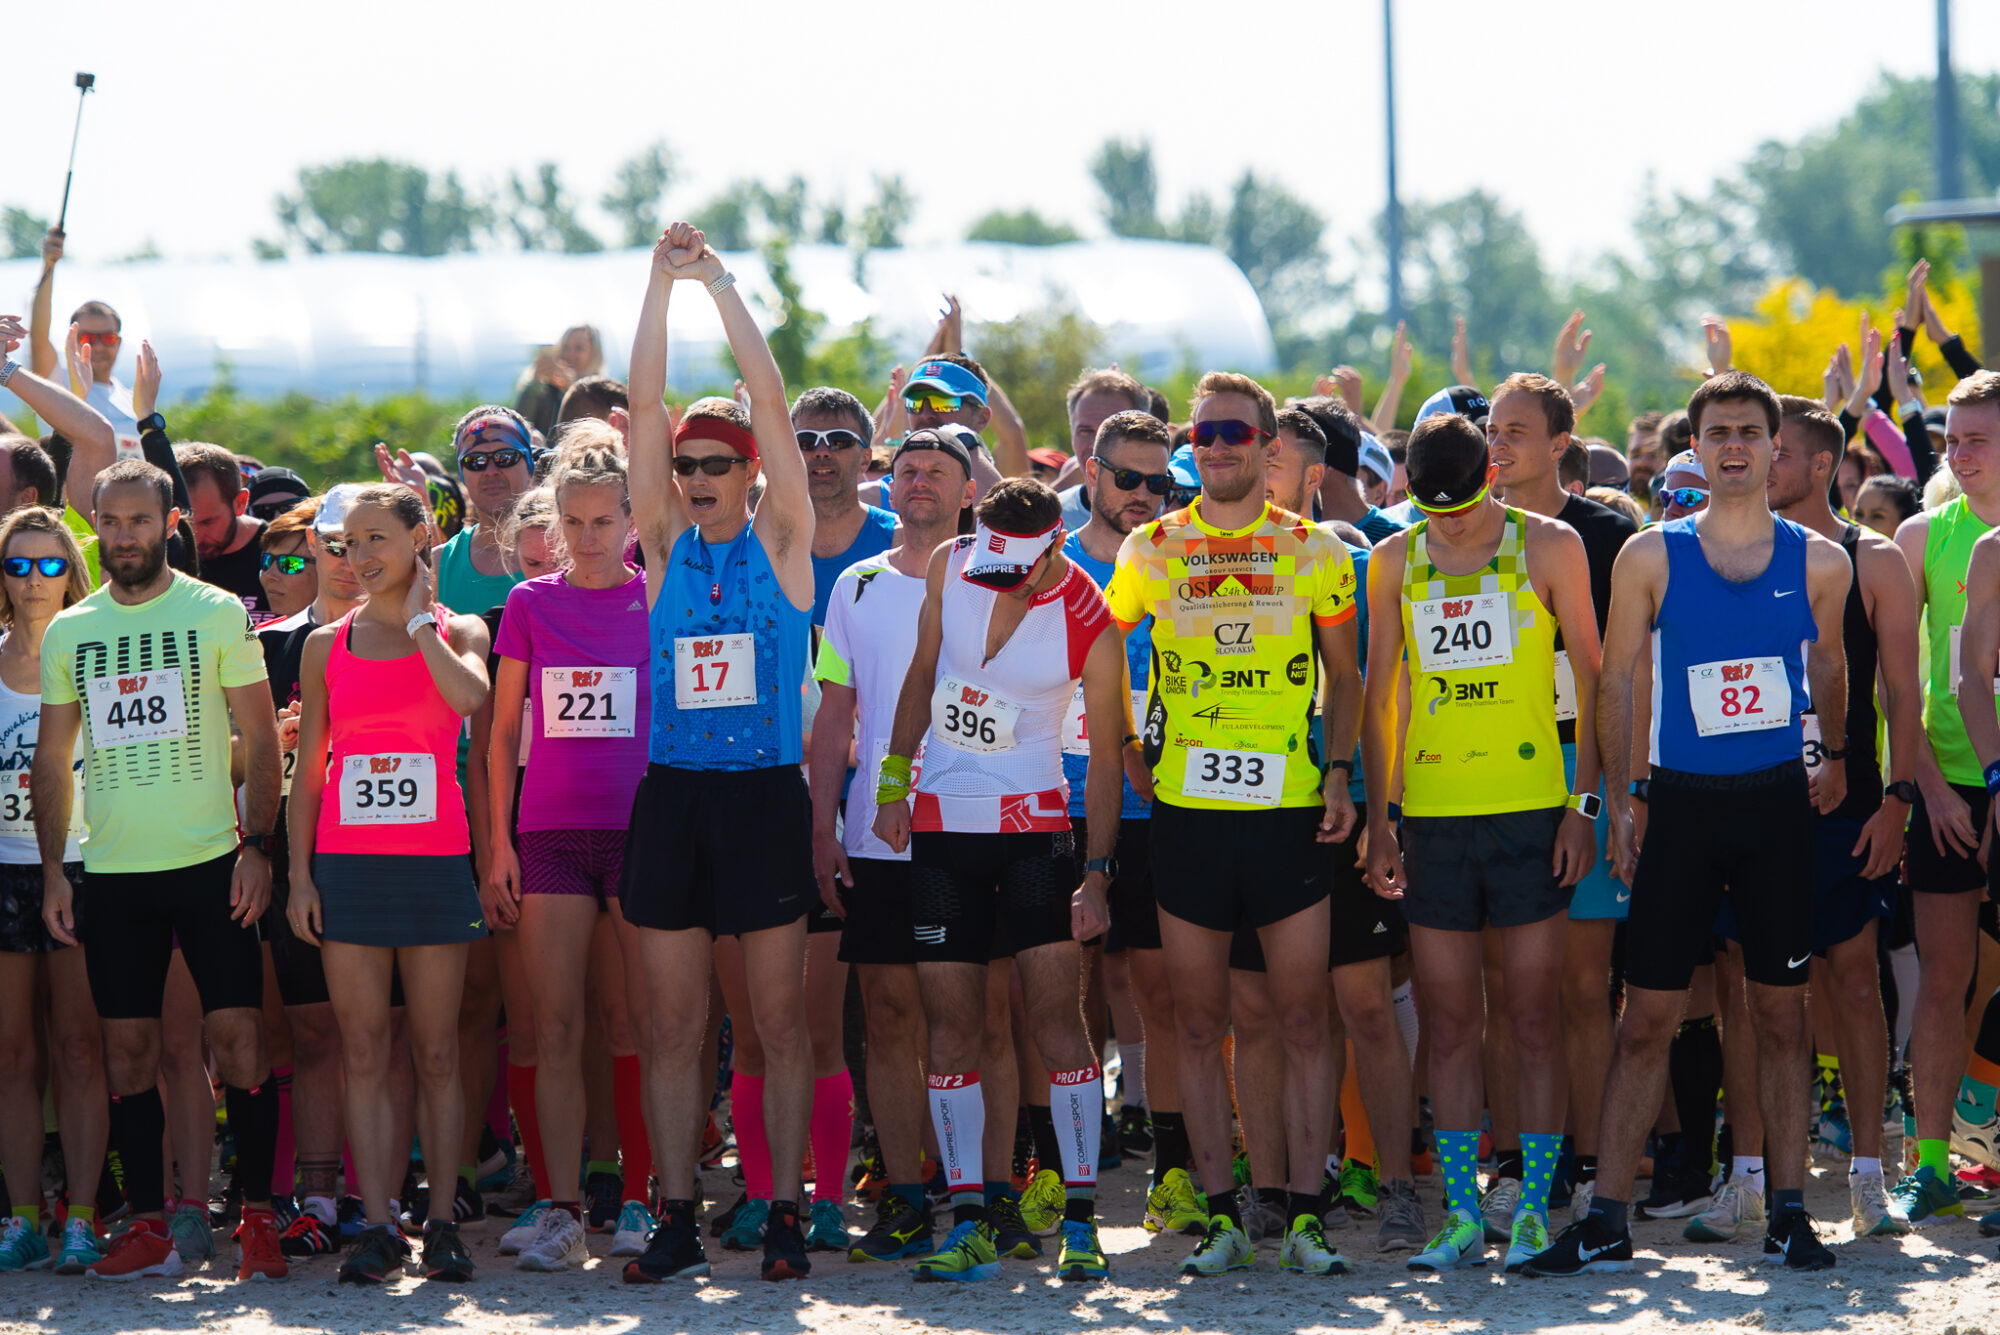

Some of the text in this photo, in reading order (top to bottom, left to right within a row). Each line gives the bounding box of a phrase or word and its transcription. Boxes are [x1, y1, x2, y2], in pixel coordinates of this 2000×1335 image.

[1181, 552, 1278, 566] VOLKSWAGEN
[1178, 580, 1284, 603] QSR 24h GROUP
[1214, 623, 1252, 645] CZ
[1430, 620, 1493, 655] 240
[1215, 646, 1256, 655] SLOVAKIA
[691, 661, 729, 692] 17
[1165, 676, 1187, 686] BIKE
[1220, 669, 1270, 688] 3NT
[1291, 670, 1307, 678] NUT
[1165, 685, 1187, 695] UNION
[1455, 681, 1499, 701] 3NT
[1720, 685, 1764, 717] 82
[107, 695, 167, 729] 448
[557, 692, 617, 720] 221
[944, 704, 996, 744] 396
[1200, 753, 1265, 787] 333
[355, 778, 418, 808] 359
[940, 1097, 957, 1168] COMPRESSPORT
[1070, 1093, 1086, 1164] COMPRESSPORT
